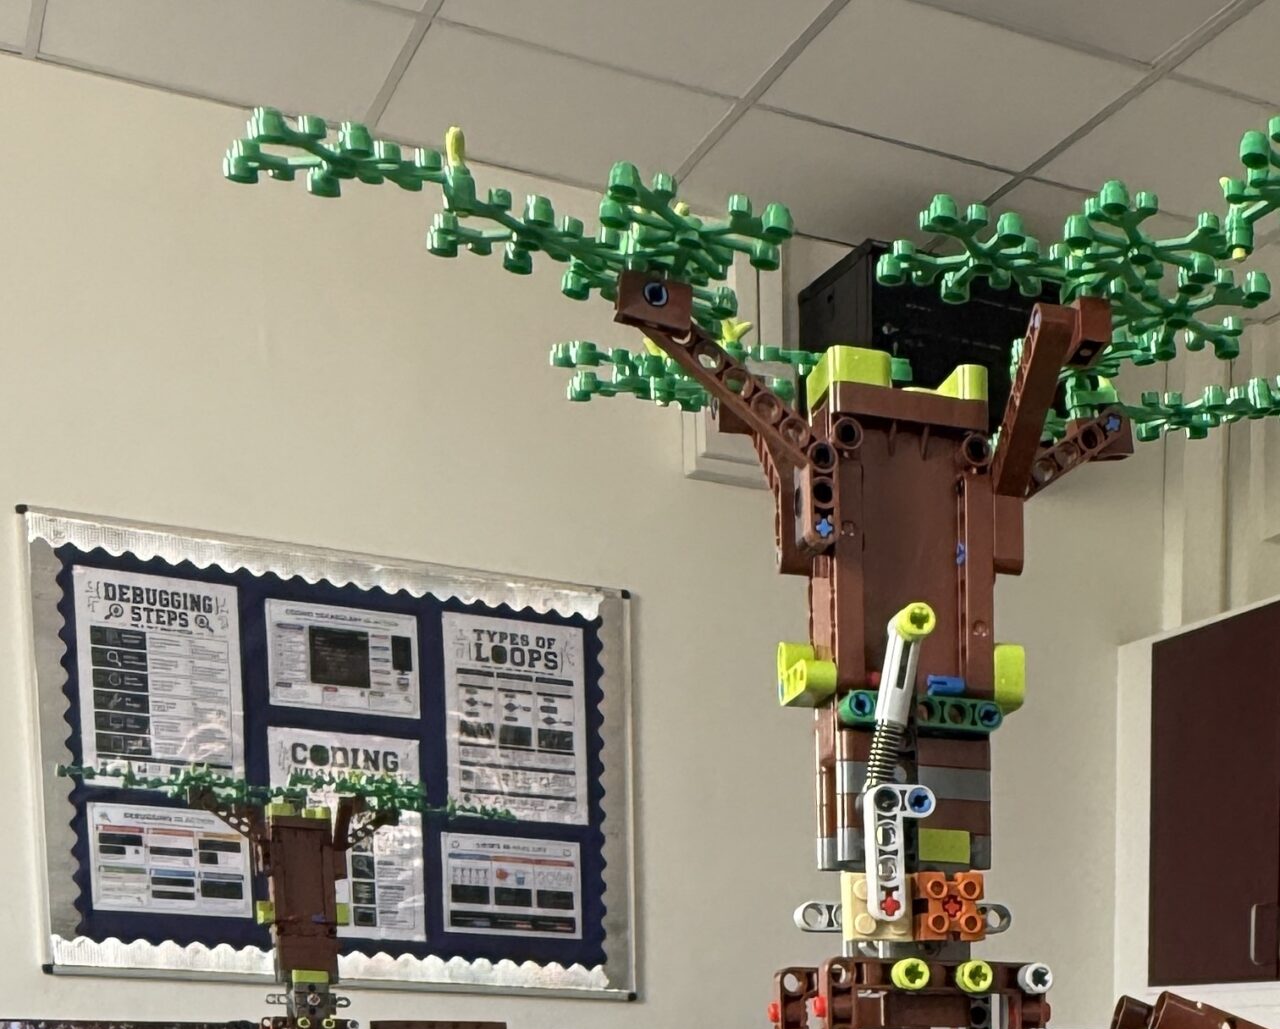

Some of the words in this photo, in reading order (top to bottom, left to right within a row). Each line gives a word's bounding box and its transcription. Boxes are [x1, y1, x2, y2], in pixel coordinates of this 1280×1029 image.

[103, 581, 213, 613] DEBUGGING
[131, 606, 189, 628] STEPS
[473, 628, 530, 647] TYPES
[536, 636, 556, 650] OF
[475, 642, 558, 670] LOOPS
[291, 742, 399, 773] CODING
